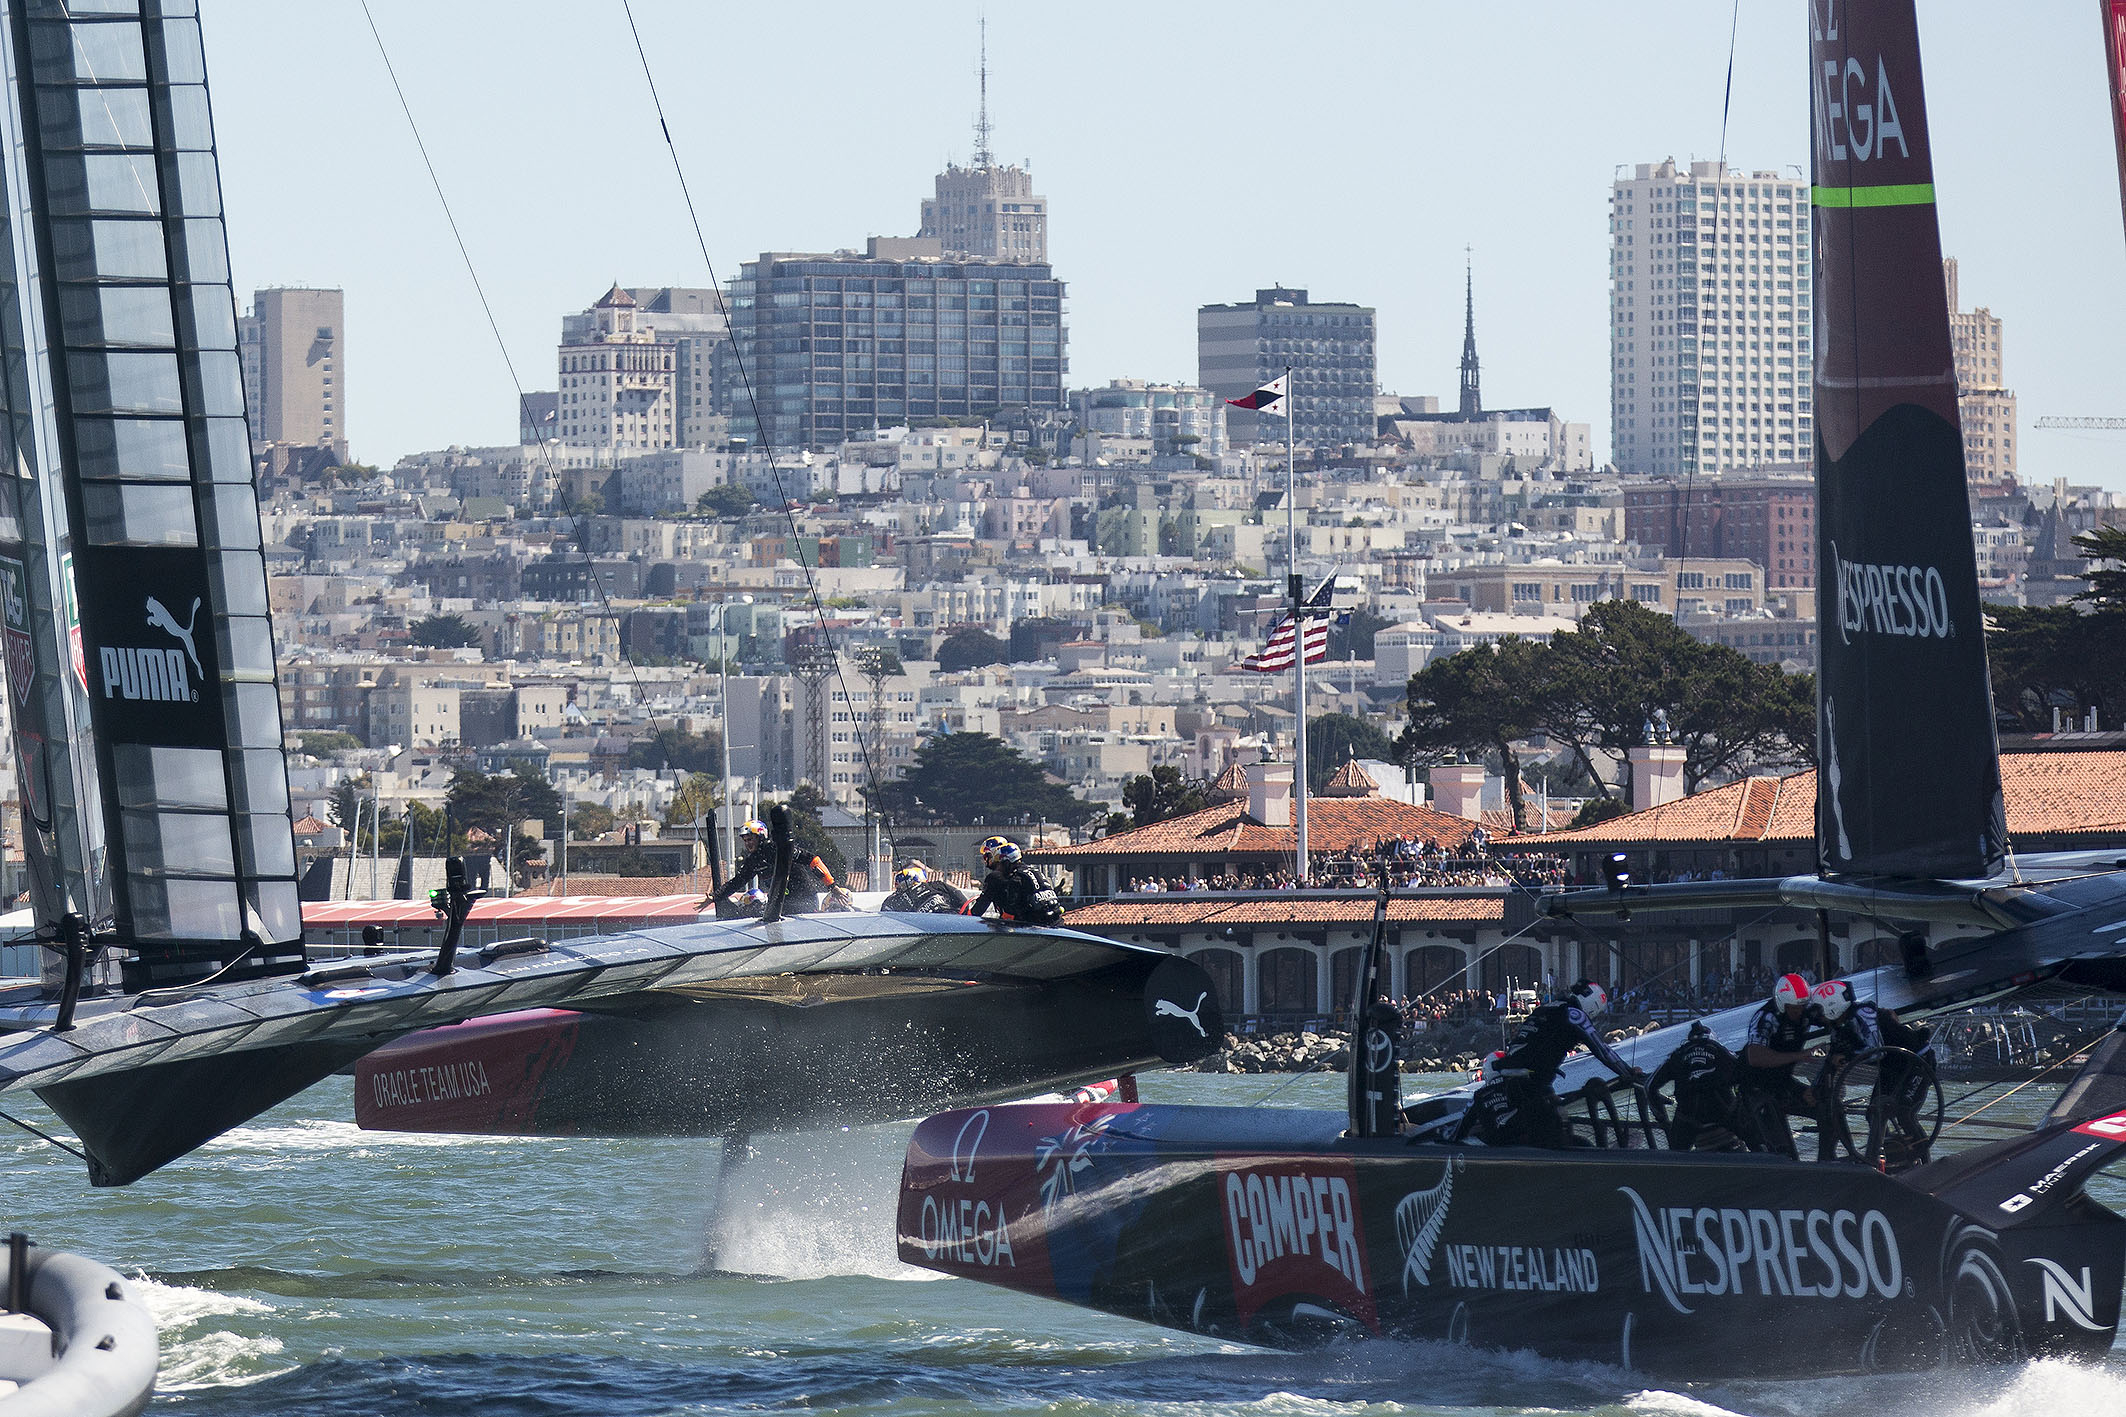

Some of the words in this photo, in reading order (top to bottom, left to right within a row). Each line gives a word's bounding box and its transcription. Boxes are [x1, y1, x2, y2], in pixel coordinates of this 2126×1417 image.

[1830, 540, 1949, 645] NESPRESSO
[100, 647, 190, 701] PUMA
[1818, 984, 1835, 999] 10
[373, 1069, 421, 1108] ORACLE
[420, 1065, 461, 1101] TEAM
[459, 1061, 491, 1097] USA
[922, 1194, 1015, 1268] OMEGA
[1226, 1172, 1366, 1295] CAMPER
[1617, 1186, 1902, 1314] NESPRESSO
[1446, 1244, 1498, 1289] NEW
[1498, 1246, 1599, 1293] ZEALAND
[2023, 1257, 2114, 1330] N
